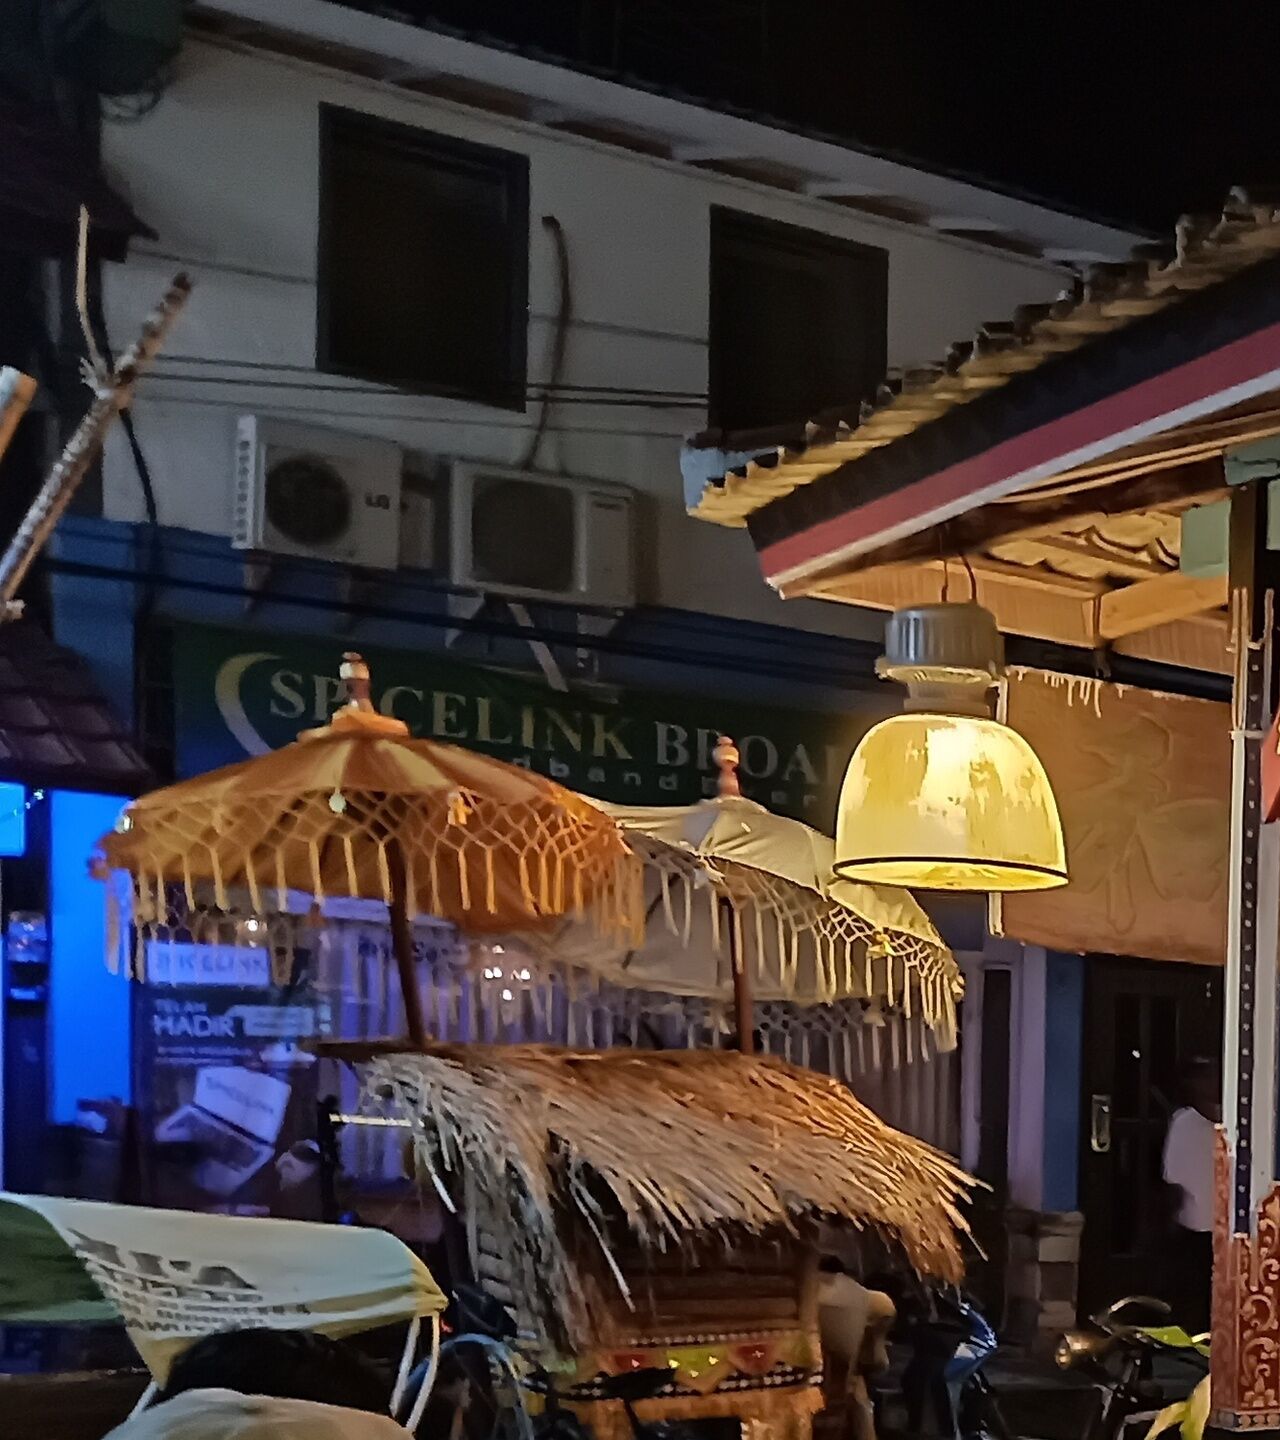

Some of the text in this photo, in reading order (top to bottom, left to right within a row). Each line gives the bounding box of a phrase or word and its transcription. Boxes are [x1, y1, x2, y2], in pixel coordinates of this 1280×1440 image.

[365, 493, 390, 510] LG
[269, 669, 633, 761] SPCELINK
[153, 1014, 234, 1037] HADIR
